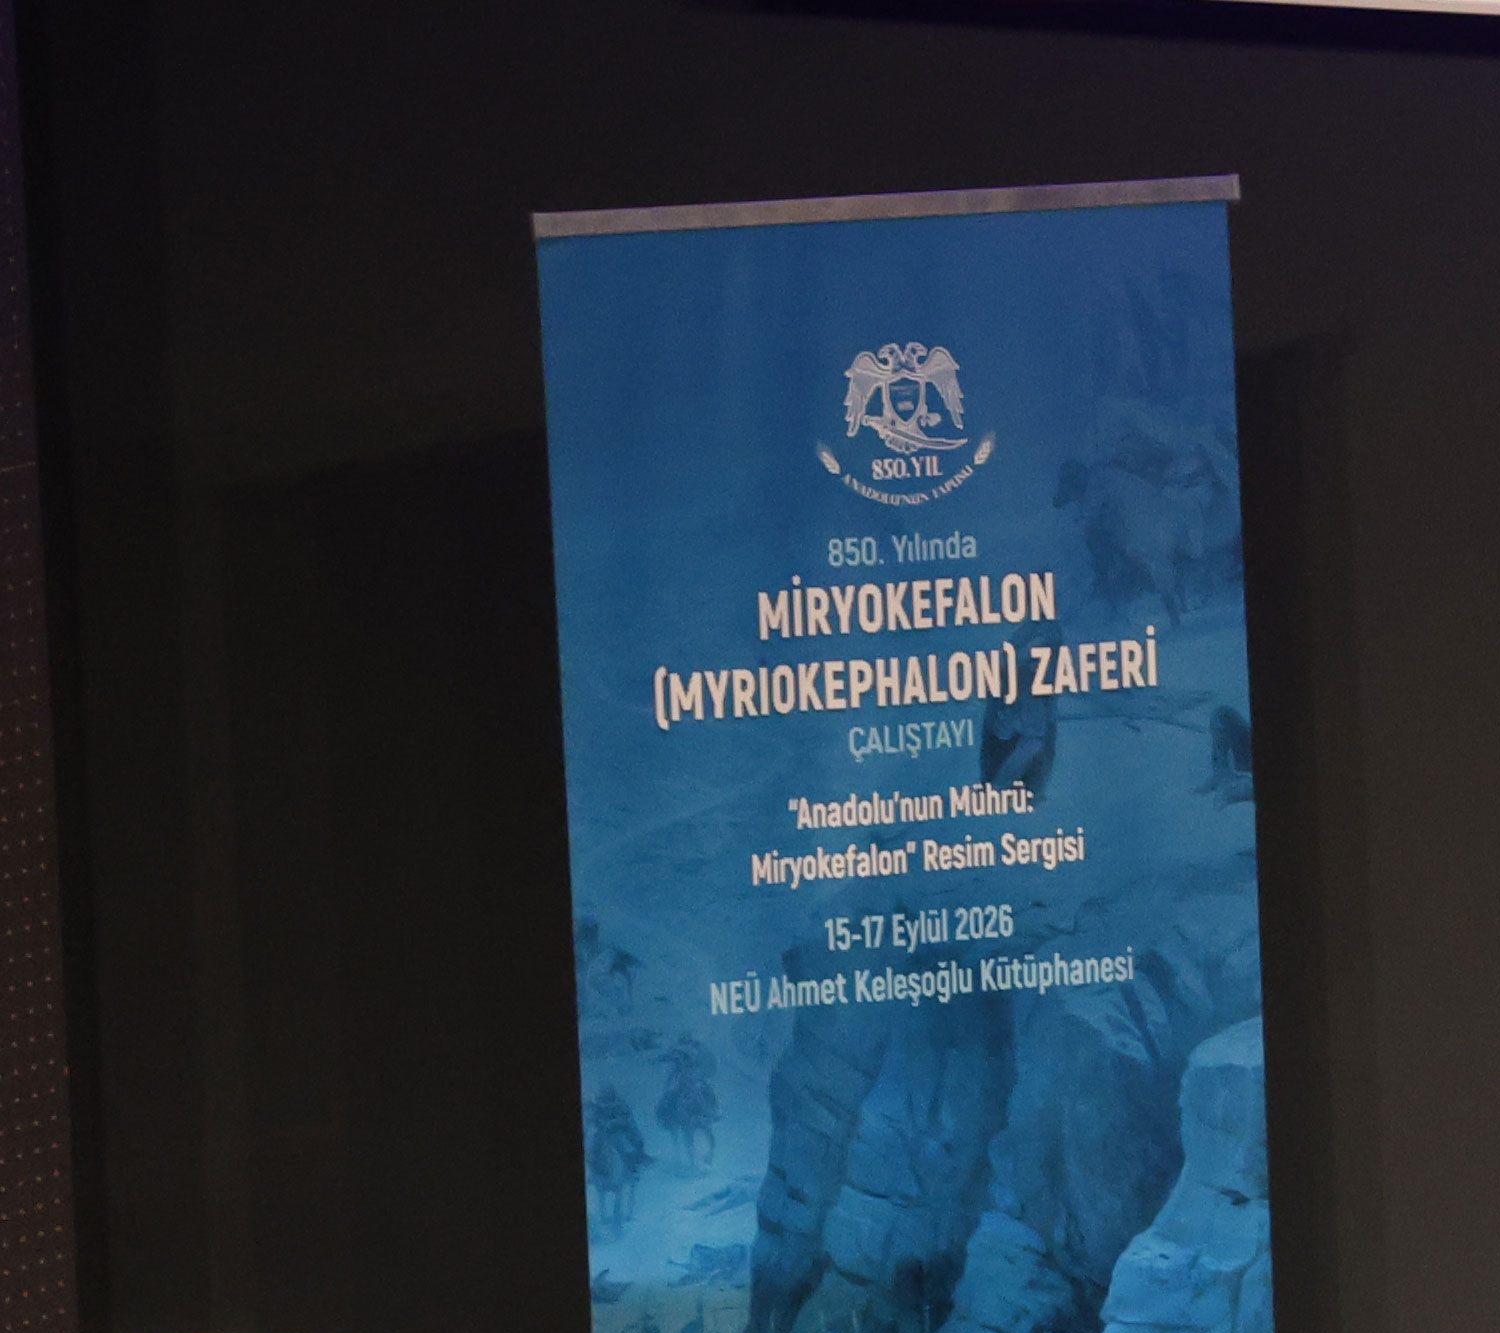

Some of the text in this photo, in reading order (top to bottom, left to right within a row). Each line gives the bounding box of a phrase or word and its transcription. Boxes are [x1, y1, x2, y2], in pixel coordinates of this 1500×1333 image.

[828, 532, 977, 566] 850. Yılında
[758, 572, 1057, 640] MİRYOKEFALON
[654, 625, 1159, 730] (MYRIOKEPHALON) ZAFERİ
[848, 722, 974, 763] ÇALIŞTAYI
[950, 784, 1034, 819] Mührü:
[924, 834, 995, 873] Resim
[1002, 827, 1085, 871] Sergisi
[825, 905, 1014, 953] 15-17 Eylül 2026
[711, 947, 1134, 1015] NEÜ Ahmet Keleşoğlu Kütüphanesi
